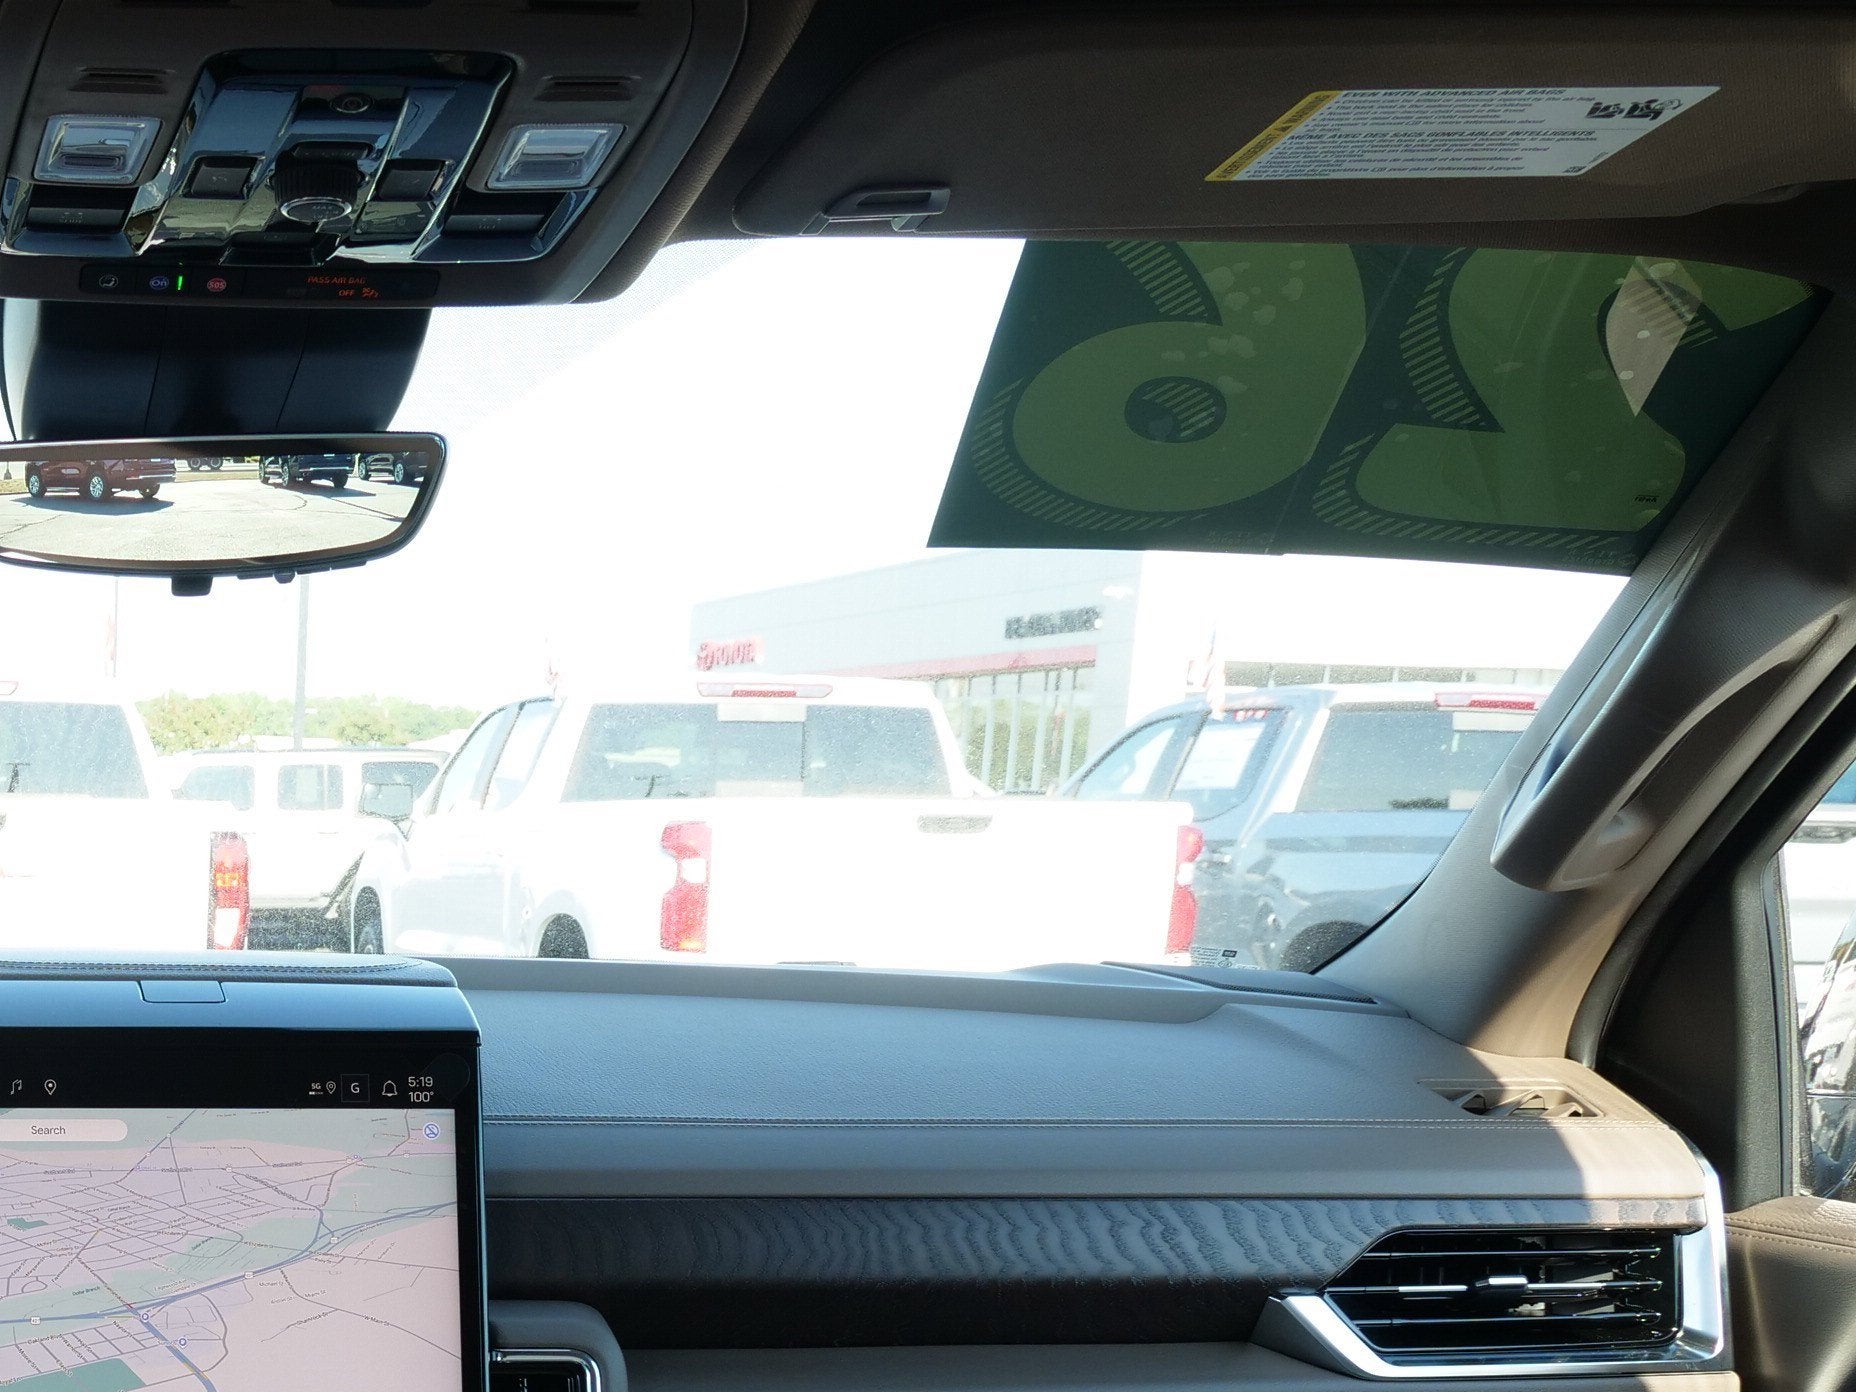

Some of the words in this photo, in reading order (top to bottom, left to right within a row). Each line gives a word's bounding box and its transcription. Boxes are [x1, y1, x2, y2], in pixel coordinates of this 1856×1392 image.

[308, 276, 330, 285] PASS
[331, 276, 348, 285] AIR
[338, 289, 355, 297] OFF
[408, 1076, 434, 1088] 5:19
[350, 1082, 360, 1094] G
[408, 1091, 435, 1103] 100°
[30, 1125, 66, 1136] Search
